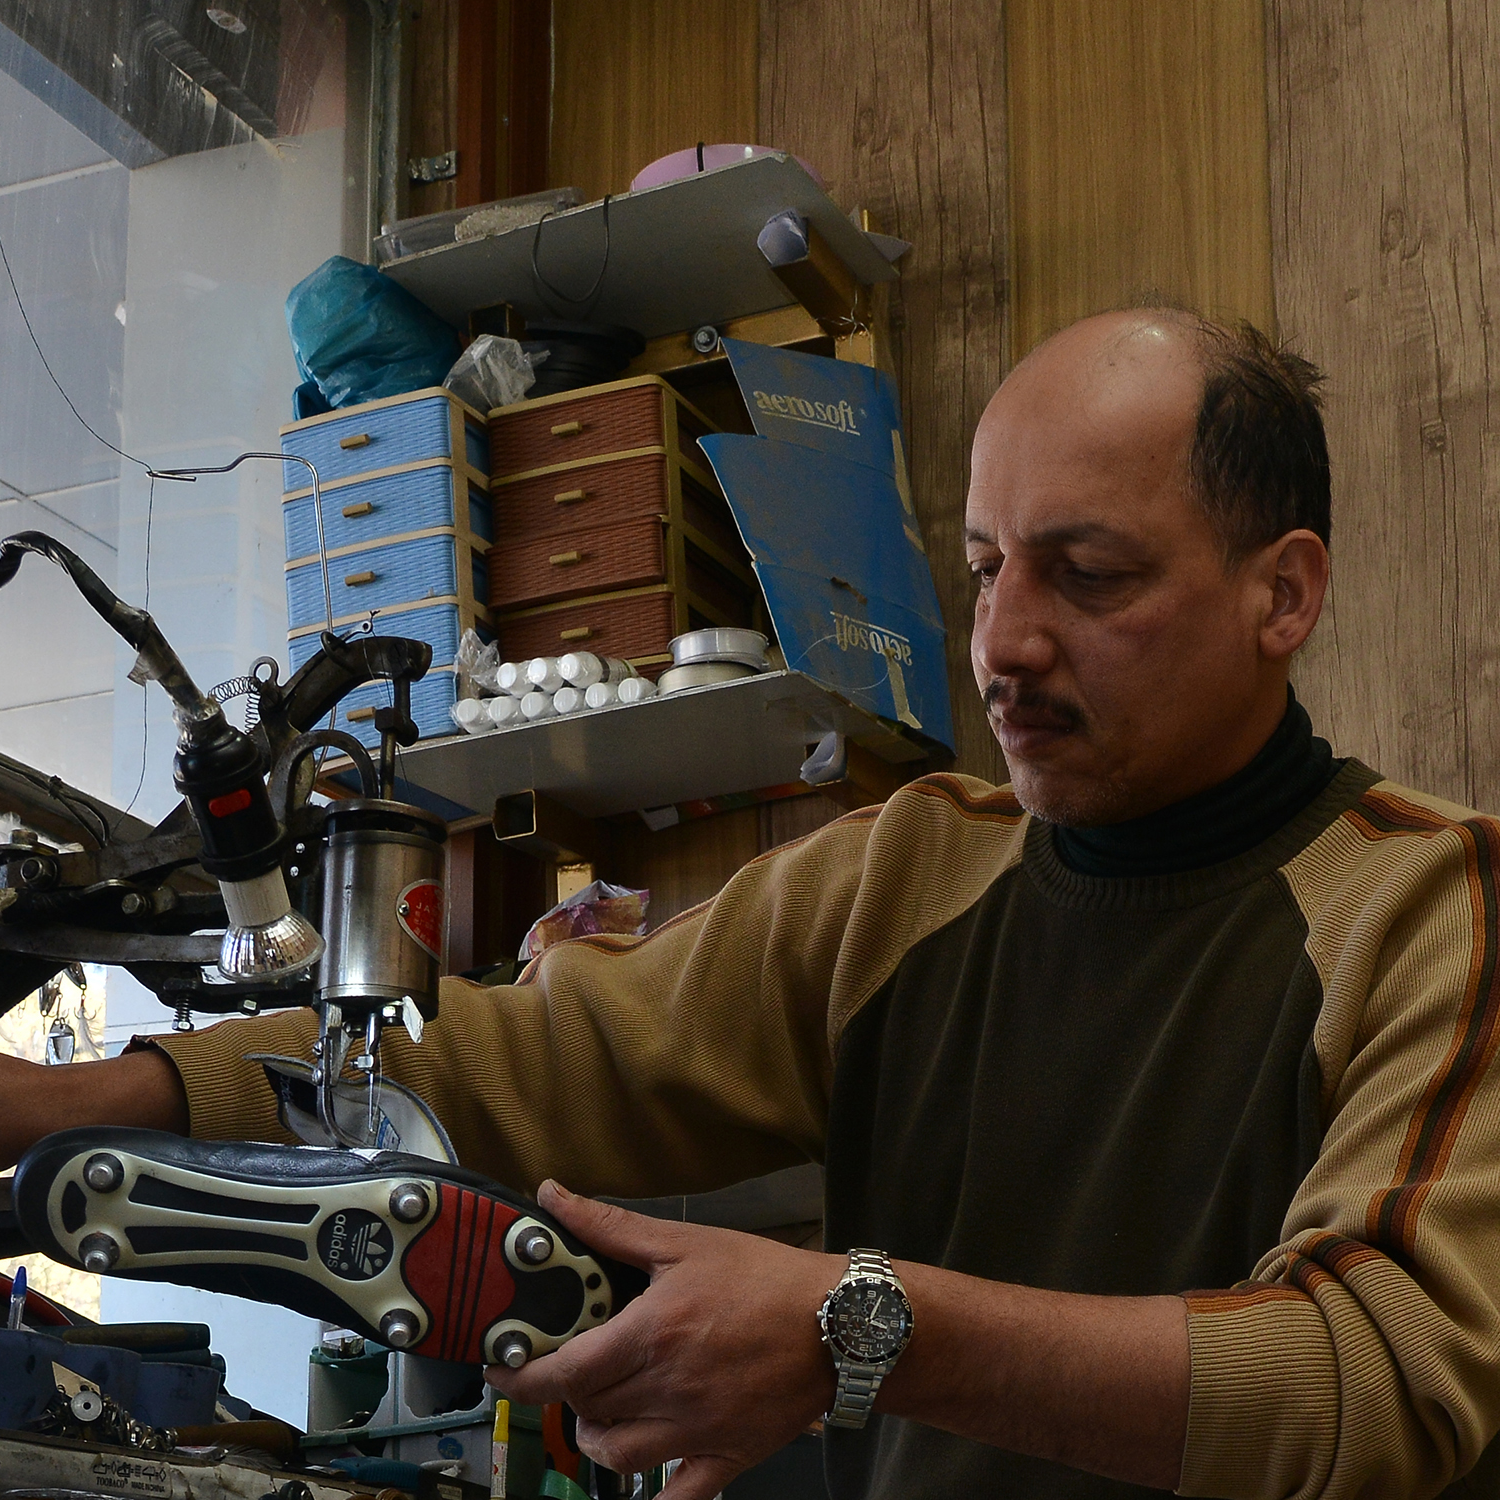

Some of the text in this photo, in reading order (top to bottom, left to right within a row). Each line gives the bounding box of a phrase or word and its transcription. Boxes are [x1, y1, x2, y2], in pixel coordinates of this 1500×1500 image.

[753, 390, 858, 432] aerosoft
[833, 614, 913, 666] aerosoft
[326, 1213, 348, 1269] adidas
